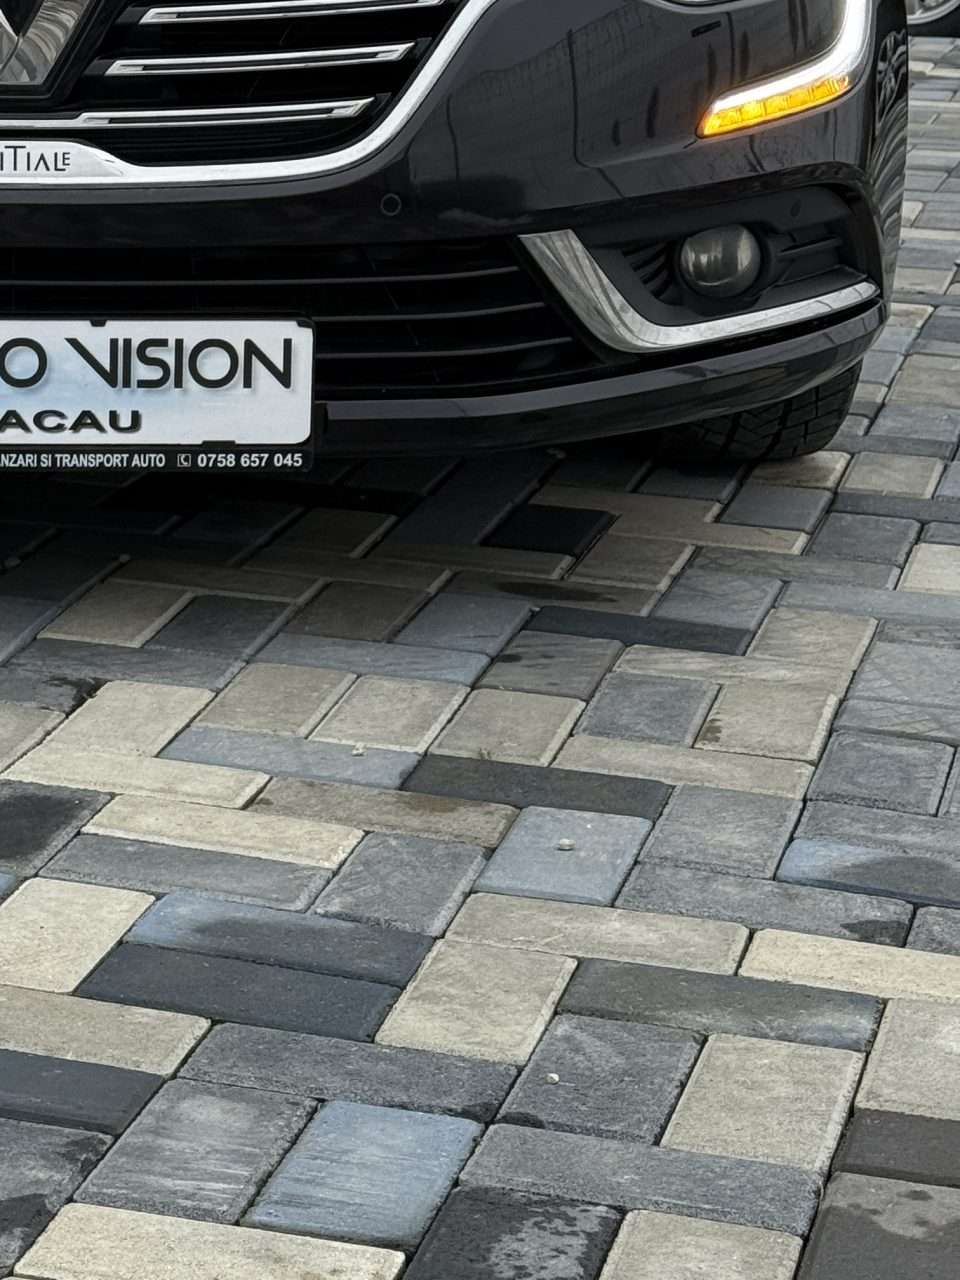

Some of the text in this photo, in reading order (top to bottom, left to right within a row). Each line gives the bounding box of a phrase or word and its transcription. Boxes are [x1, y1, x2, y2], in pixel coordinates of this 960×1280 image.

[65, 337, 293, 389] VISION
[40, 453, 52, 468] SI
[55, 453, 129, 468] TRANSPORT
[131, 453, 166, 468] AUTO
[197, 453, 236, 468] 0758
[239, 453, 269, 468] 657
[273, 453, 303, 468] 045
